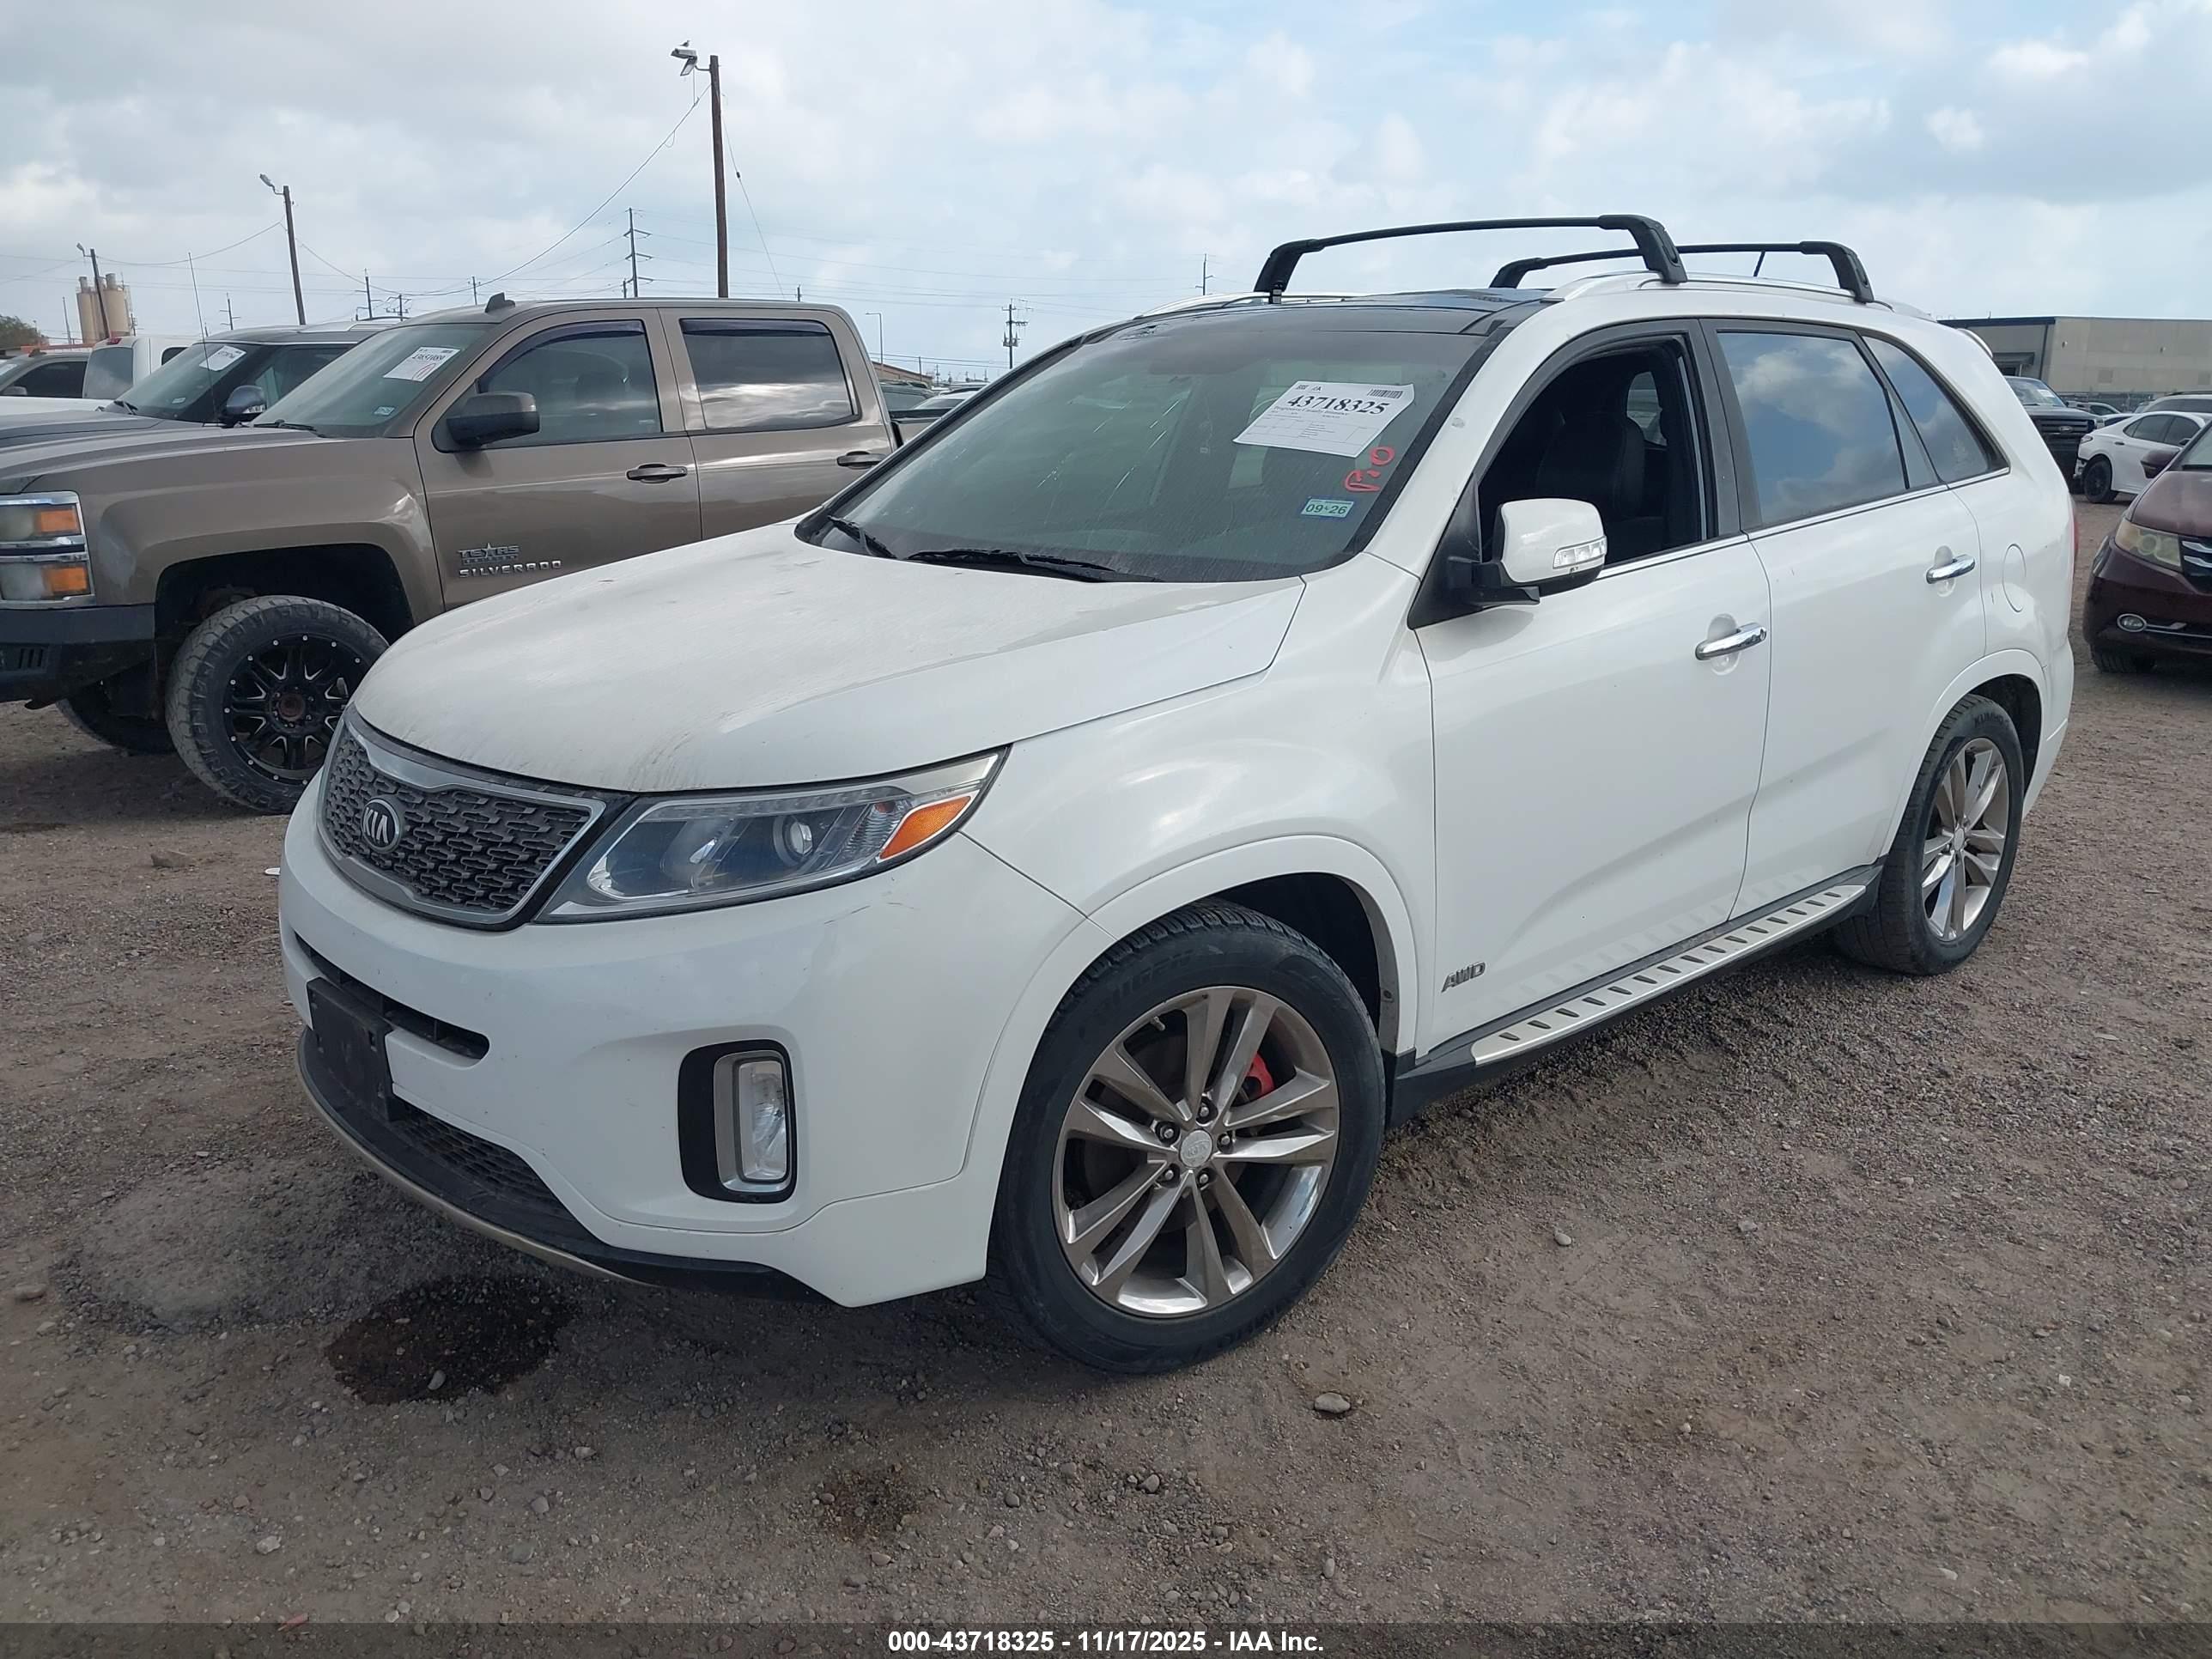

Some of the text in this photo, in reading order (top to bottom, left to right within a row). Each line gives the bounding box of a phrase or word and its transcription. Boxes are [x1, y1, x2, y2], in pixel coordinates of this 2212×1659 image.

[1288, 395, 1390, 415] 43718325
[459, 560, 562, 578] SILVERADO
[362, 806, 389, 844] KIA
[1441, 961, 1486, 993] AWD
